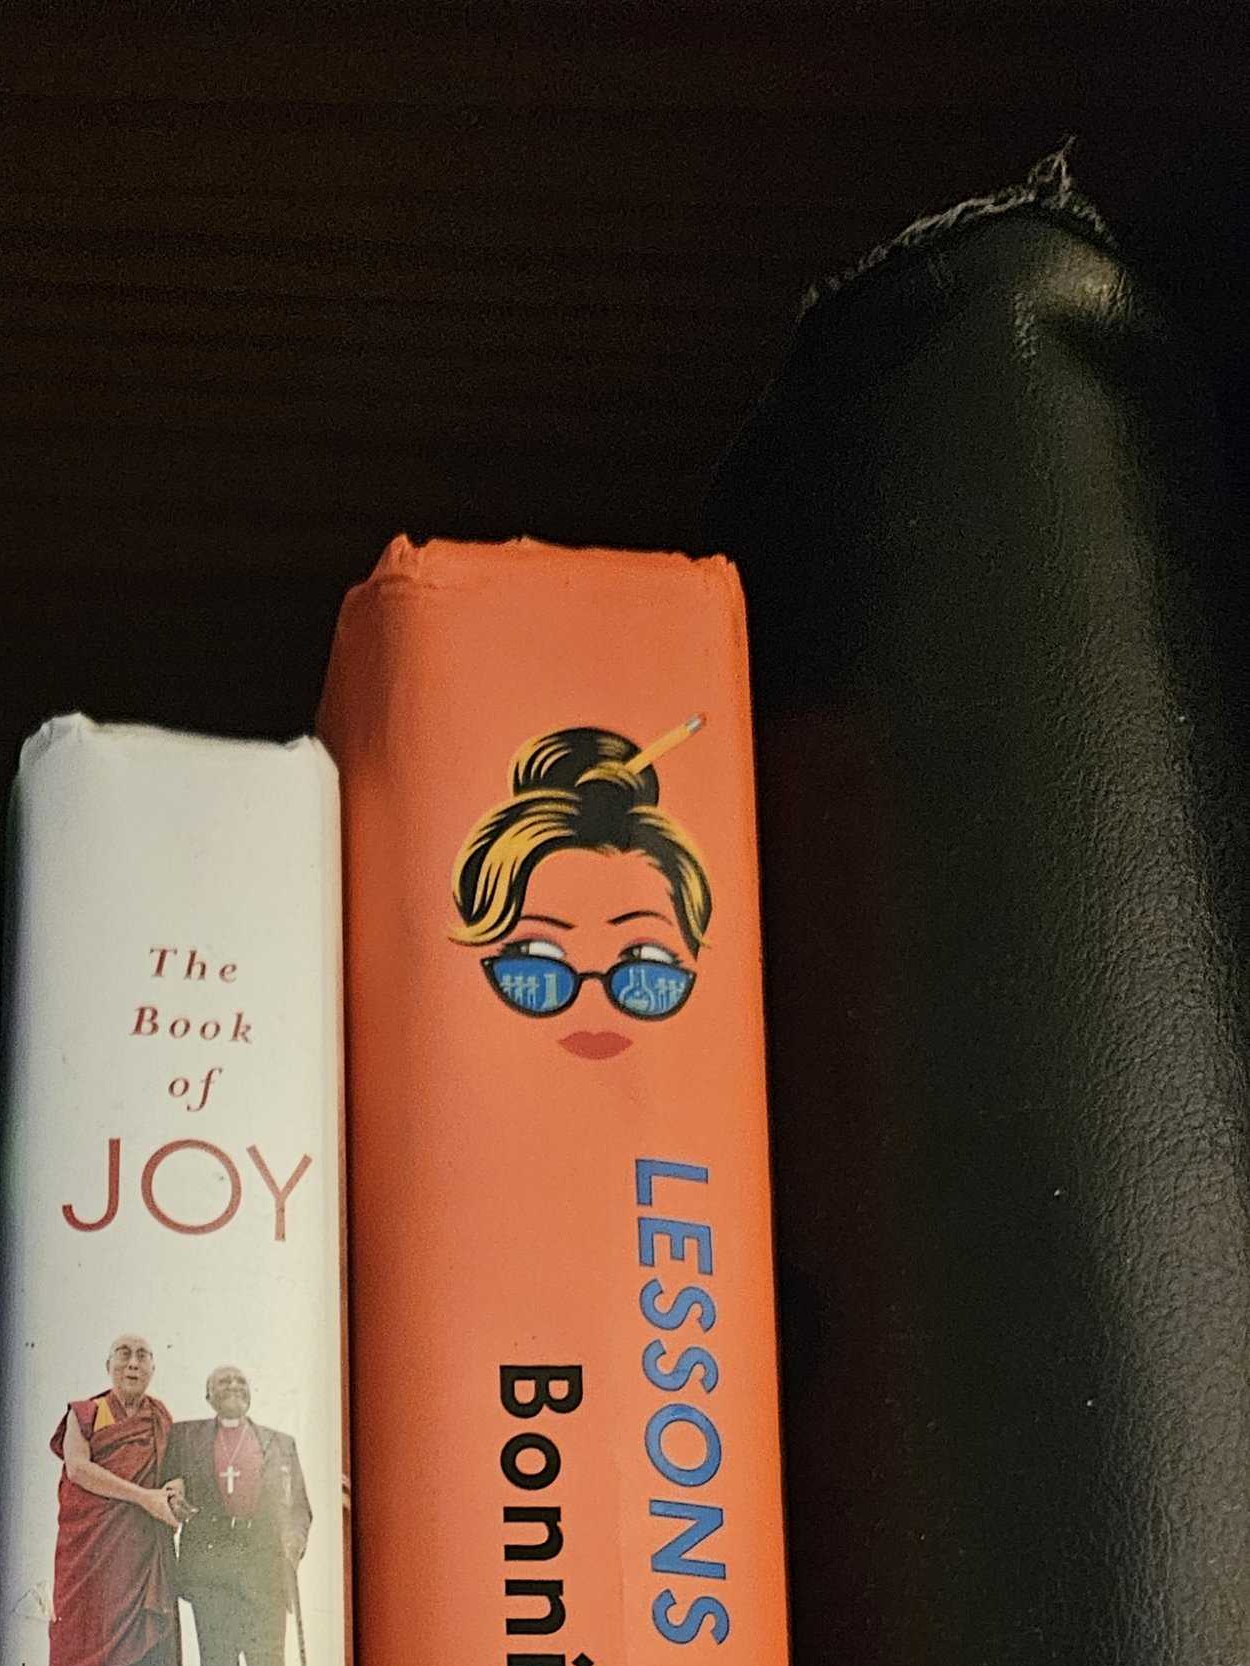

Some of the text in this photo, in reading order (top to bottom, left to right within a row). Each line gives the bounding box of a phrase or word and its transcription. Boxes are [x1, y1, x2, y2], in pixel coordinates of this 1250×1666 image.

[148, 946, 240, 985] The
[131, 1004, 253, 1046] Book
[168, 1066, 224, 1111] of
[62, 1138, 312, 1242] JOY
[636, 1158, 731, 1645] LESSONS
